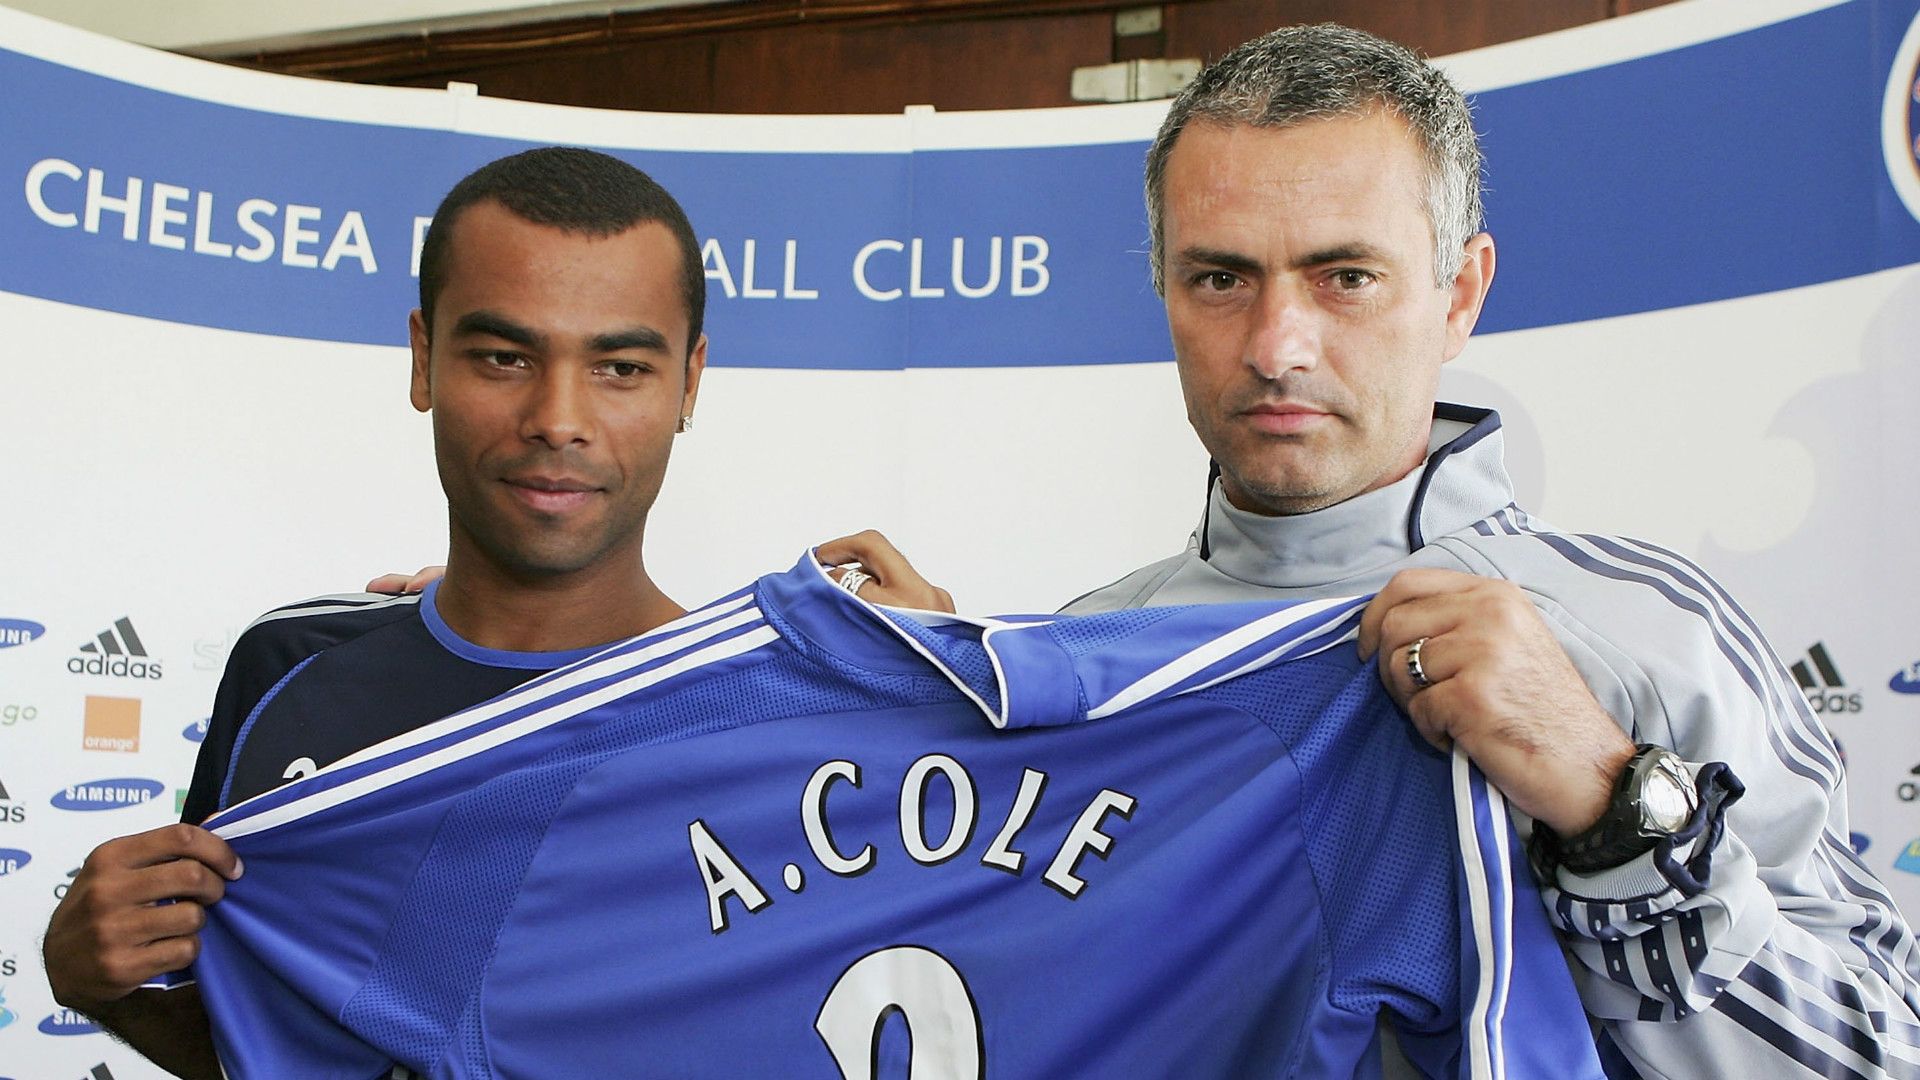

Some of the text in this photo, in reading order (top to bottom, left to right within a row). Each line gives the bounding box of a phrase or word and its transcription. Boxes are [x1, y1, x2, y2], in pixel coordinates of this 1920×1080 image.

[24, 158, 378, 274] CHELSEA
[853, 235, 1050, 301] CLUB
[67, 654, 162, 679] adidas
[85, 736, 134, 751] orange
[65, 786, 151, 803] SAMSUNG
[687, 752, 1138, 934] A.COLE
